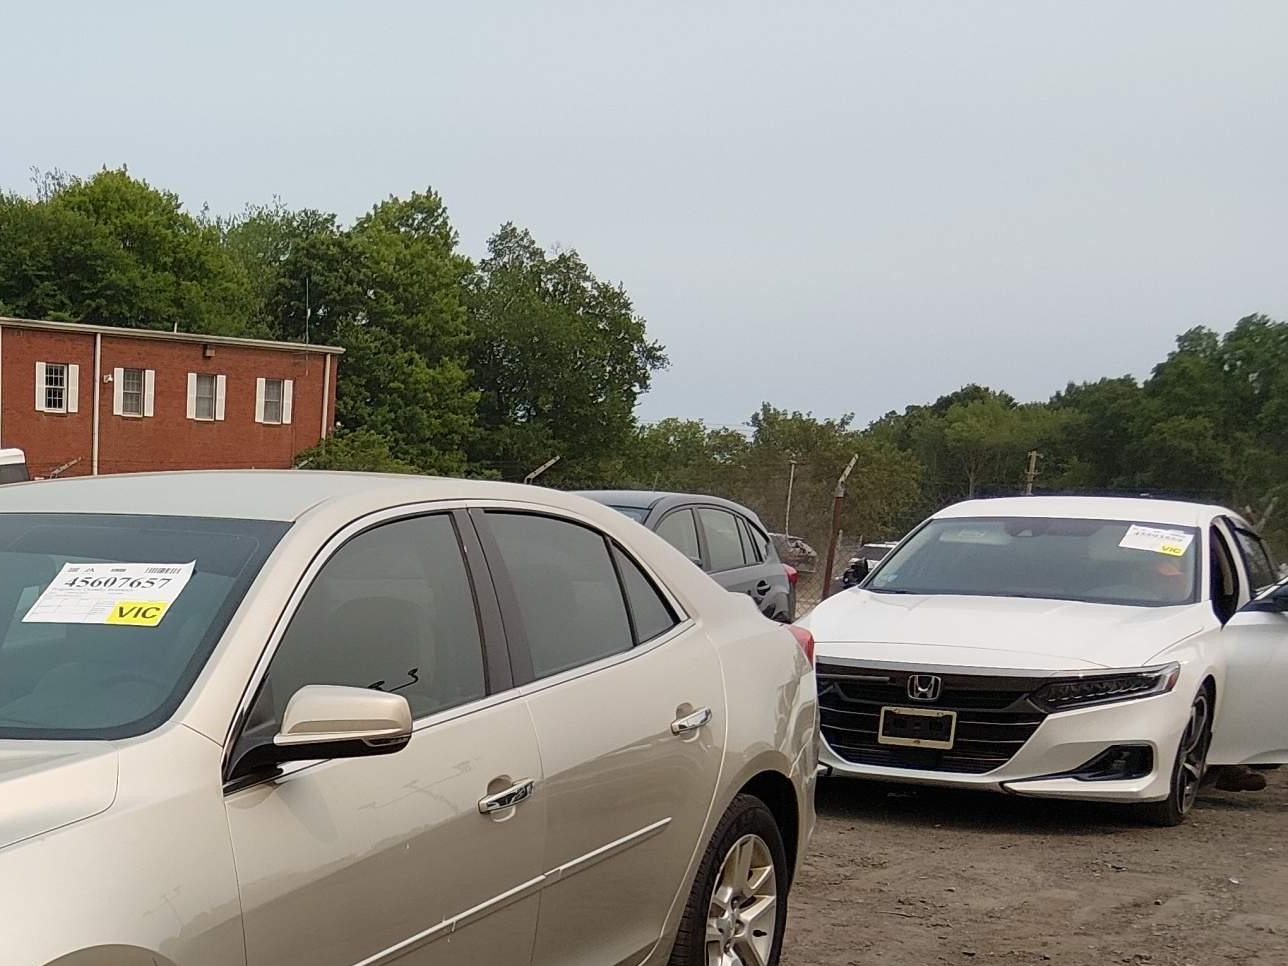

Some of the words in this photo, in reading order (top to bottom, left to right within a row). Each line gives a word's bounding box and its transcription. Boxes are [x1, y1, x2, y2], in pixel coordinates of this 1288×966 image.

[1161, 545, 1182, 554] VIC
[64, 576, 173, 589] 45607657
[117, 606, 161, 619] VIC
